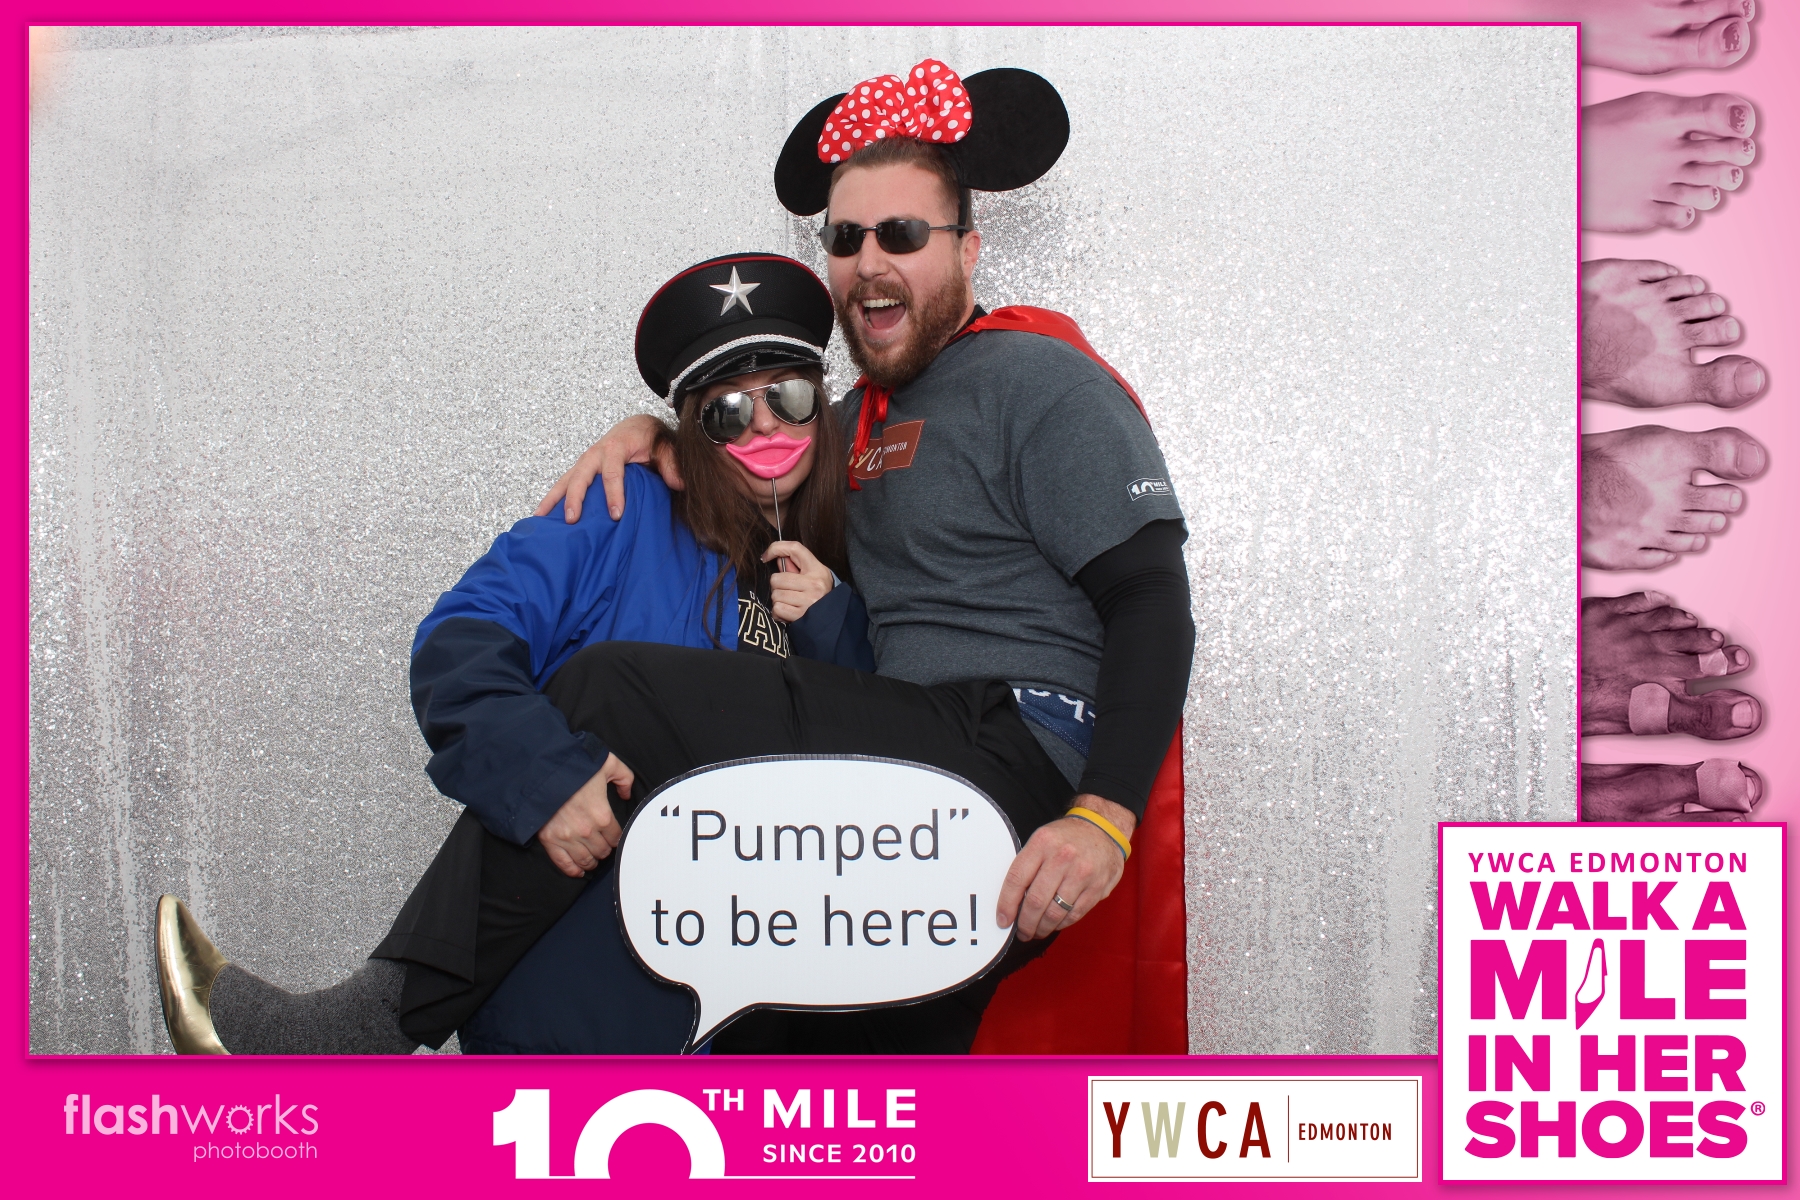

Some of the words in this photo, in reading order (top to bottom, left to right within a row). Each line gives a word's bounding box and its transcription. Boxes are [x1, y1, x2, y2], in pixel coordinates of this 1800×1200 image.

[651, 899, 705, 947] to
[730, 894, 798, 947] be
[823, 894, 978, 947] here!
